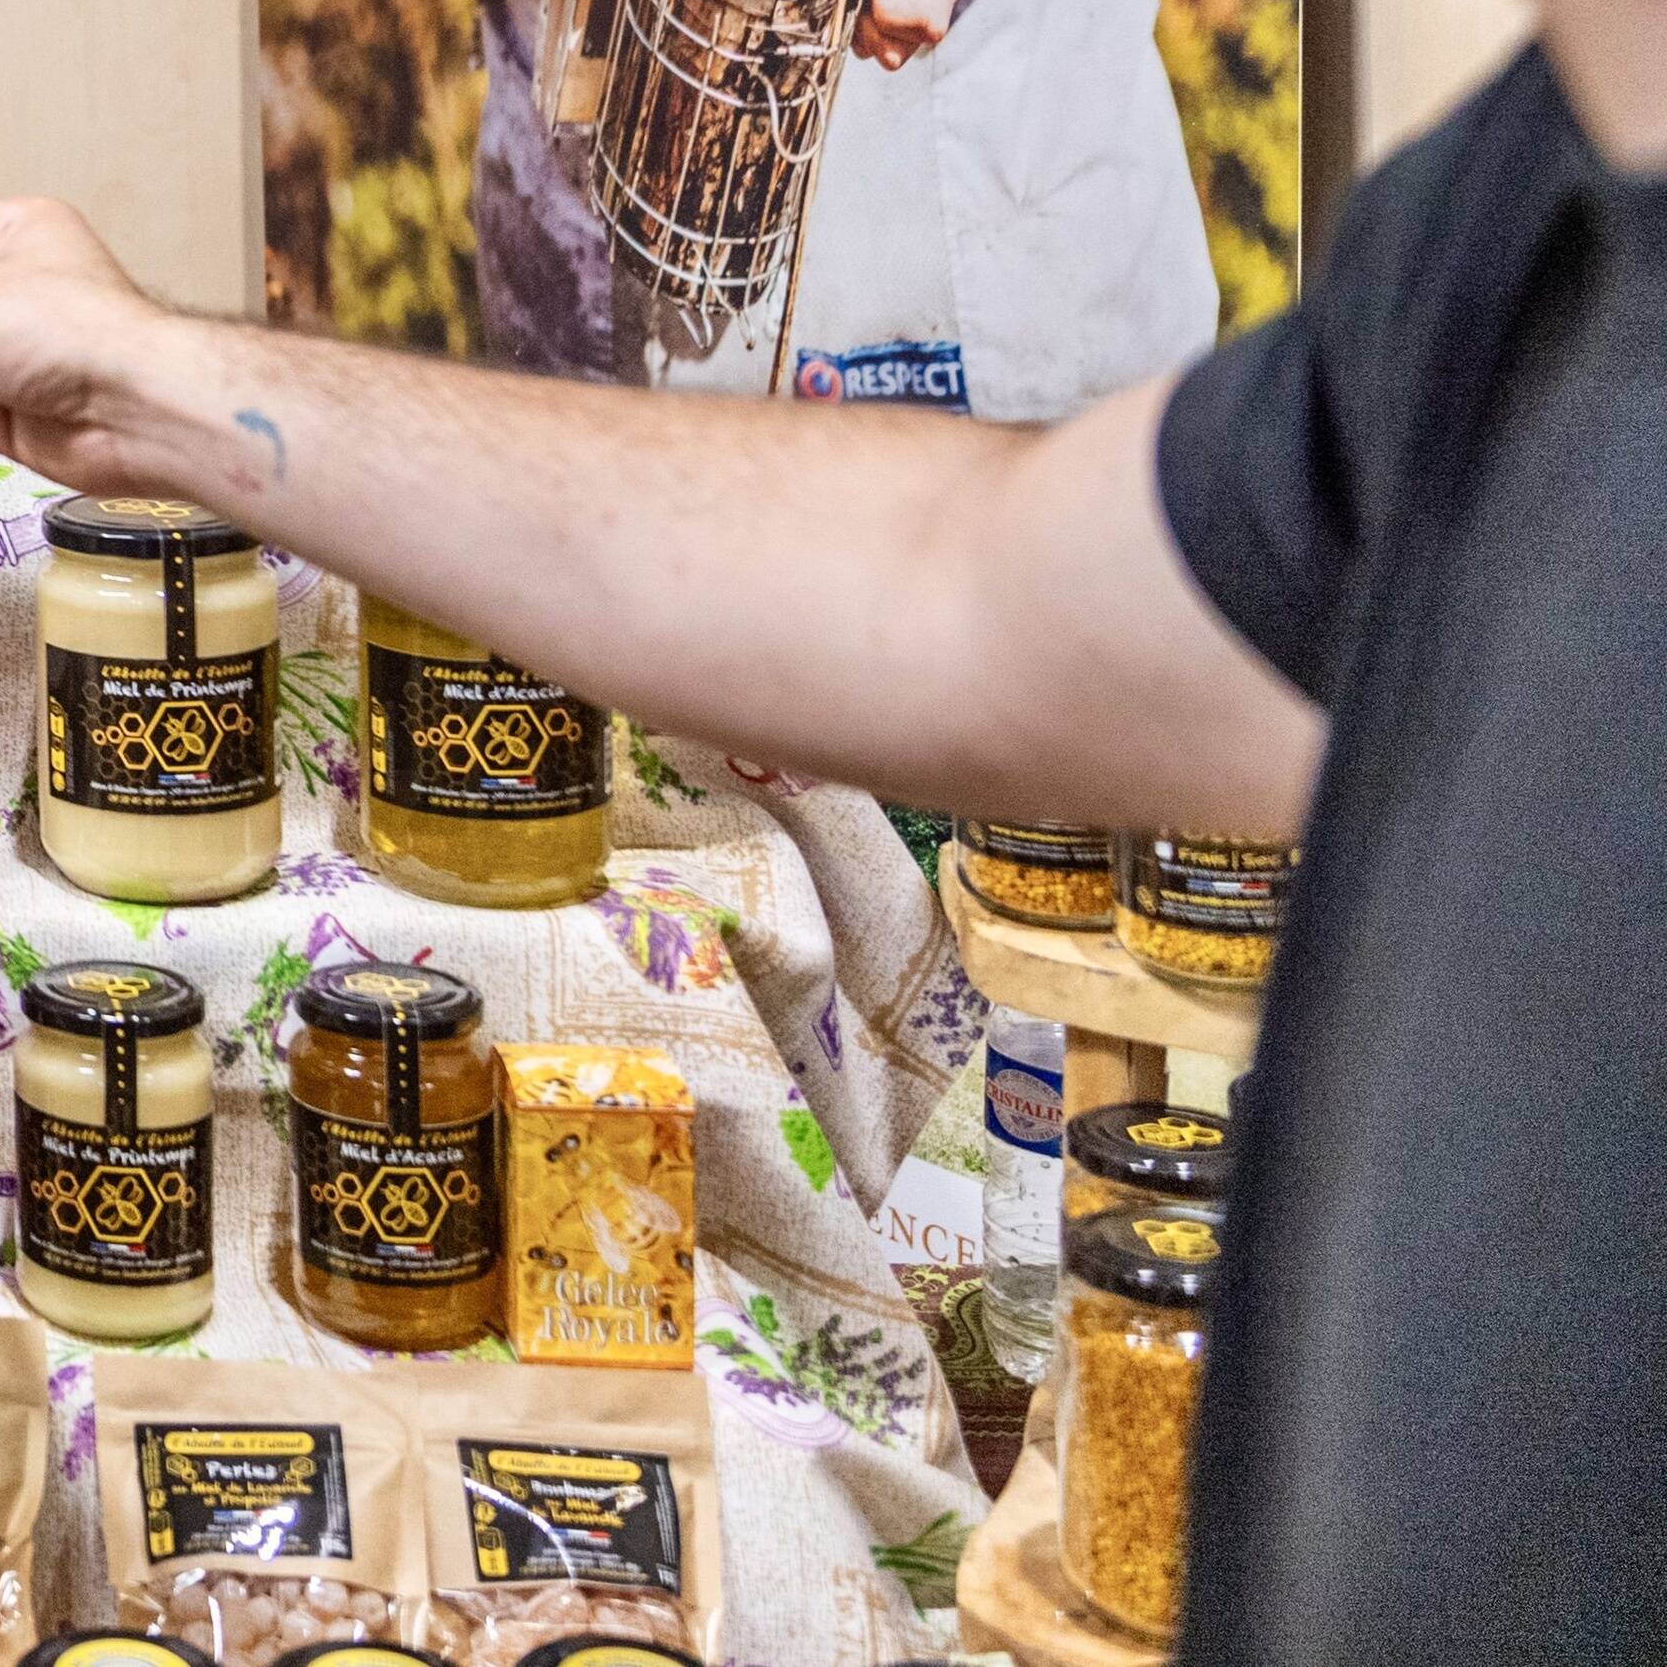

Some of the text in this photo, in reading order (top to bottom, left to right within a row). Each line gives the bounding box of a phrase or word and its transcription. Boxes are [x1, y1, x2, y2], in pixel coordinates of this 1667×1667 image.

[844, 361, 962, 398] RESPECT
[171, 677, 253, 699] Printemps
[537, 1306, 677, 1352] Royale
